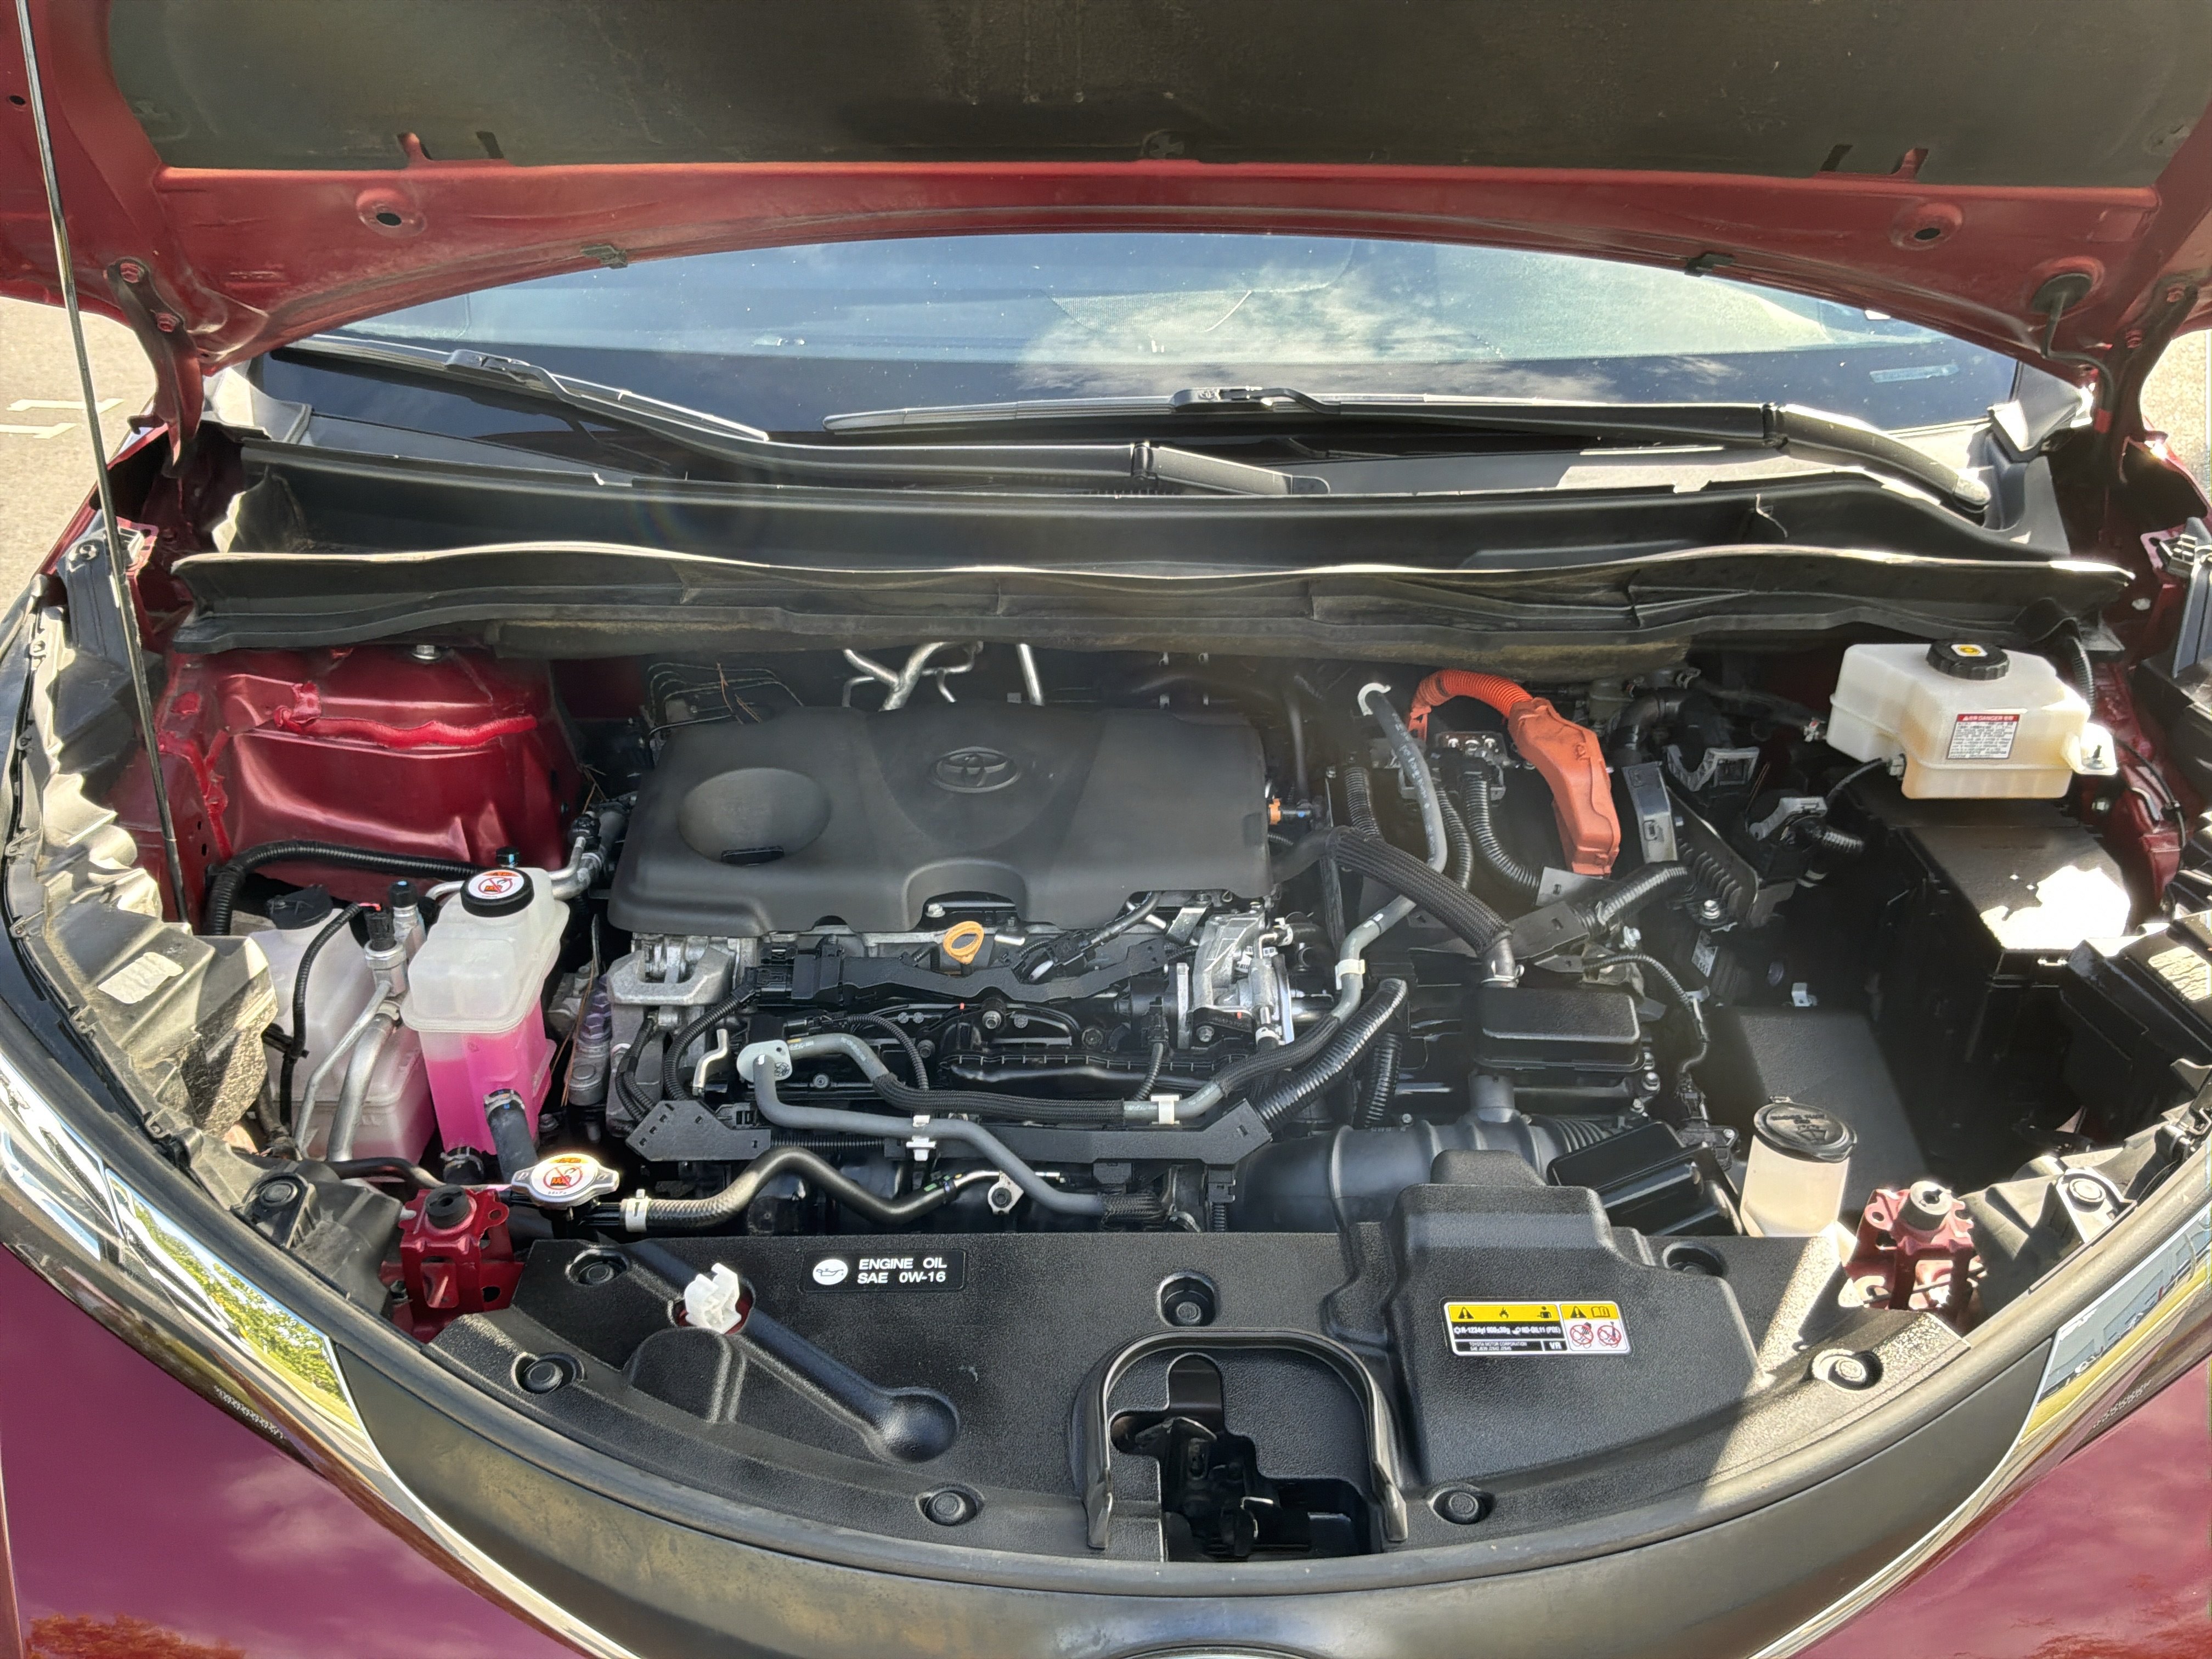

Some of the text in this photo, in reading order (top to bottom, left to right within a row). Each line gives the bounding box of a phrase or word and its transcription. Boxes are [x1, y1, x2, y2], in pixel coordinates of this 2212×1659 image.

[859, 1257, 947, 1270] ENGINE OIL
[857, 1271, 946, 1284] SAE 0W-16
